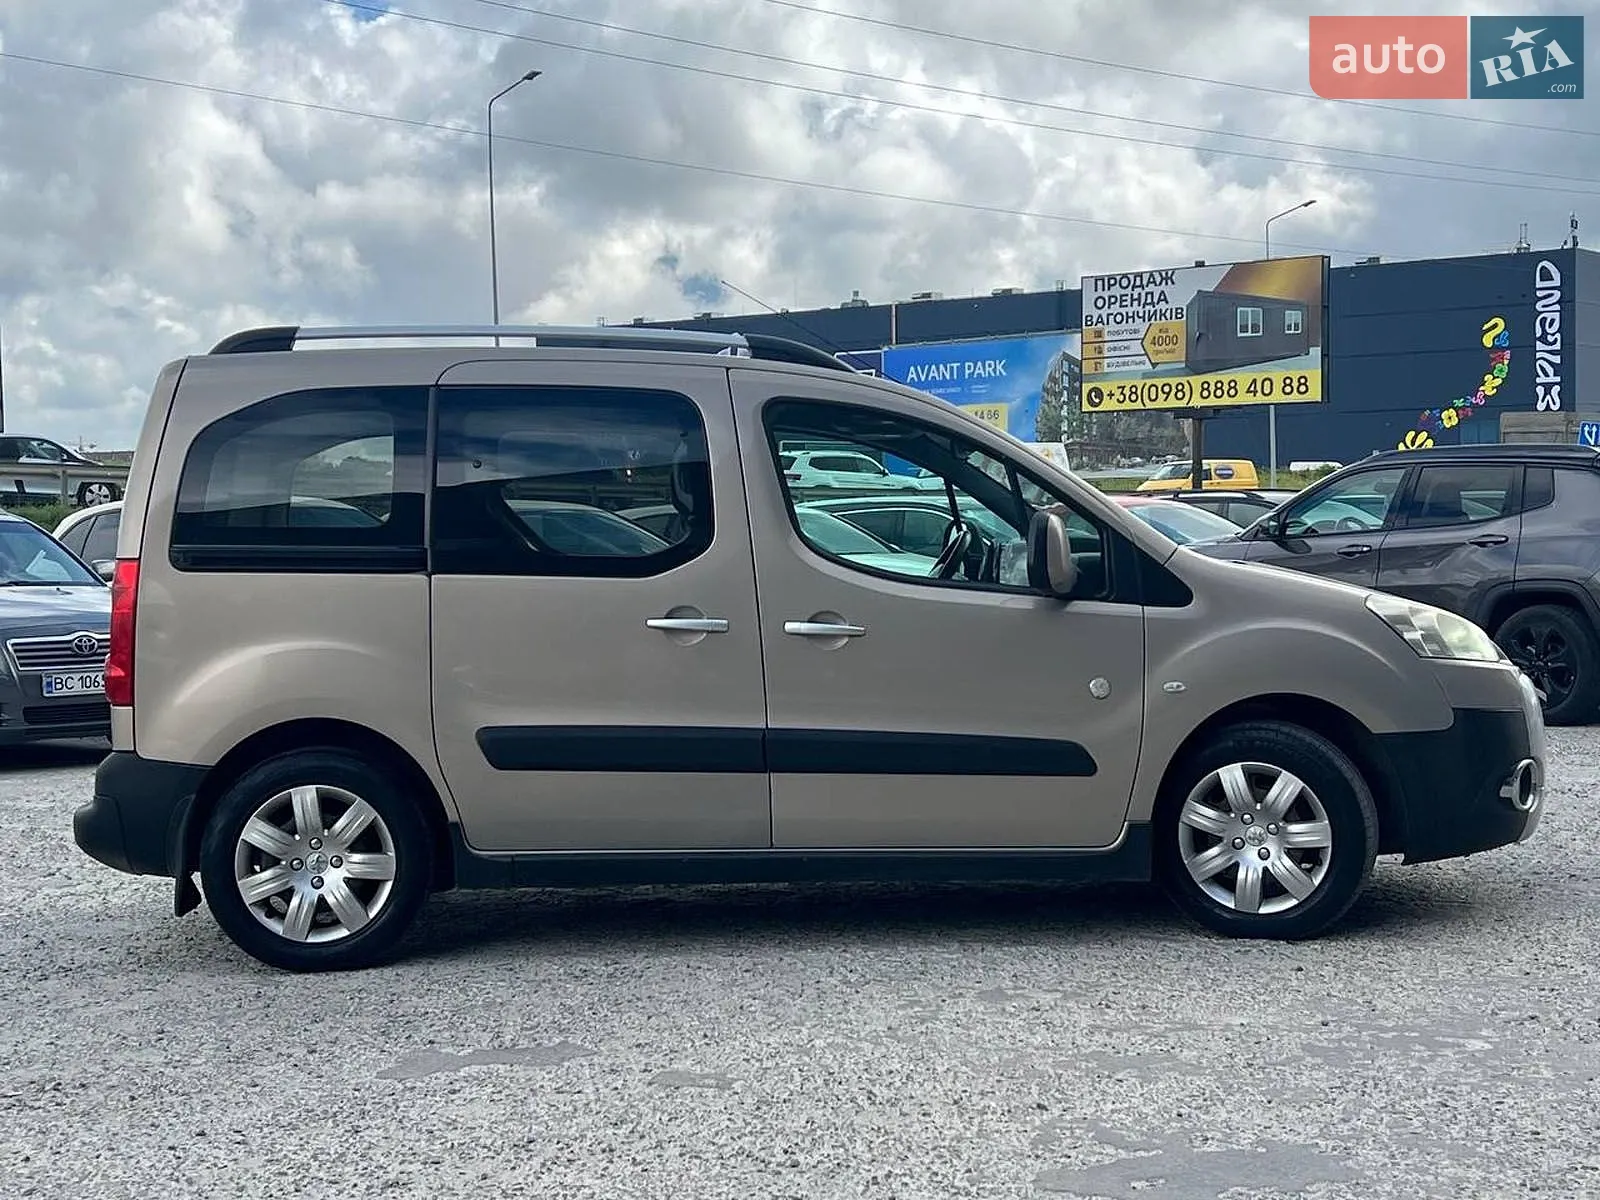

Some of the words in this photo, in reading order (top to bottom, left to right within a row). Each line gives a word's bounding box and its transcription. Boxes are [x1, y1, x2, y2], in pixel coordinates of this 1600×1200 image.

[1093, 270, 1175, 293] ПРОДАЖ
[1093, 290, 1169, 311] ОРЕНДА
[1084, 306, 1185, 327] ВАГОНЧИКІВ
[1149, 334, 1179, 347] 4000
[906, 362, 961, 384] AVANT
[964, 359, 1007, 379] PARK
[1107, 380, 1193, 408] +38(098)
[1200, 379, 1239, 400] 888
[1246, 377, 1273, 397] 40
[1282, 375, 1309, 395] 88
[54, 675, 75, 691] BC
